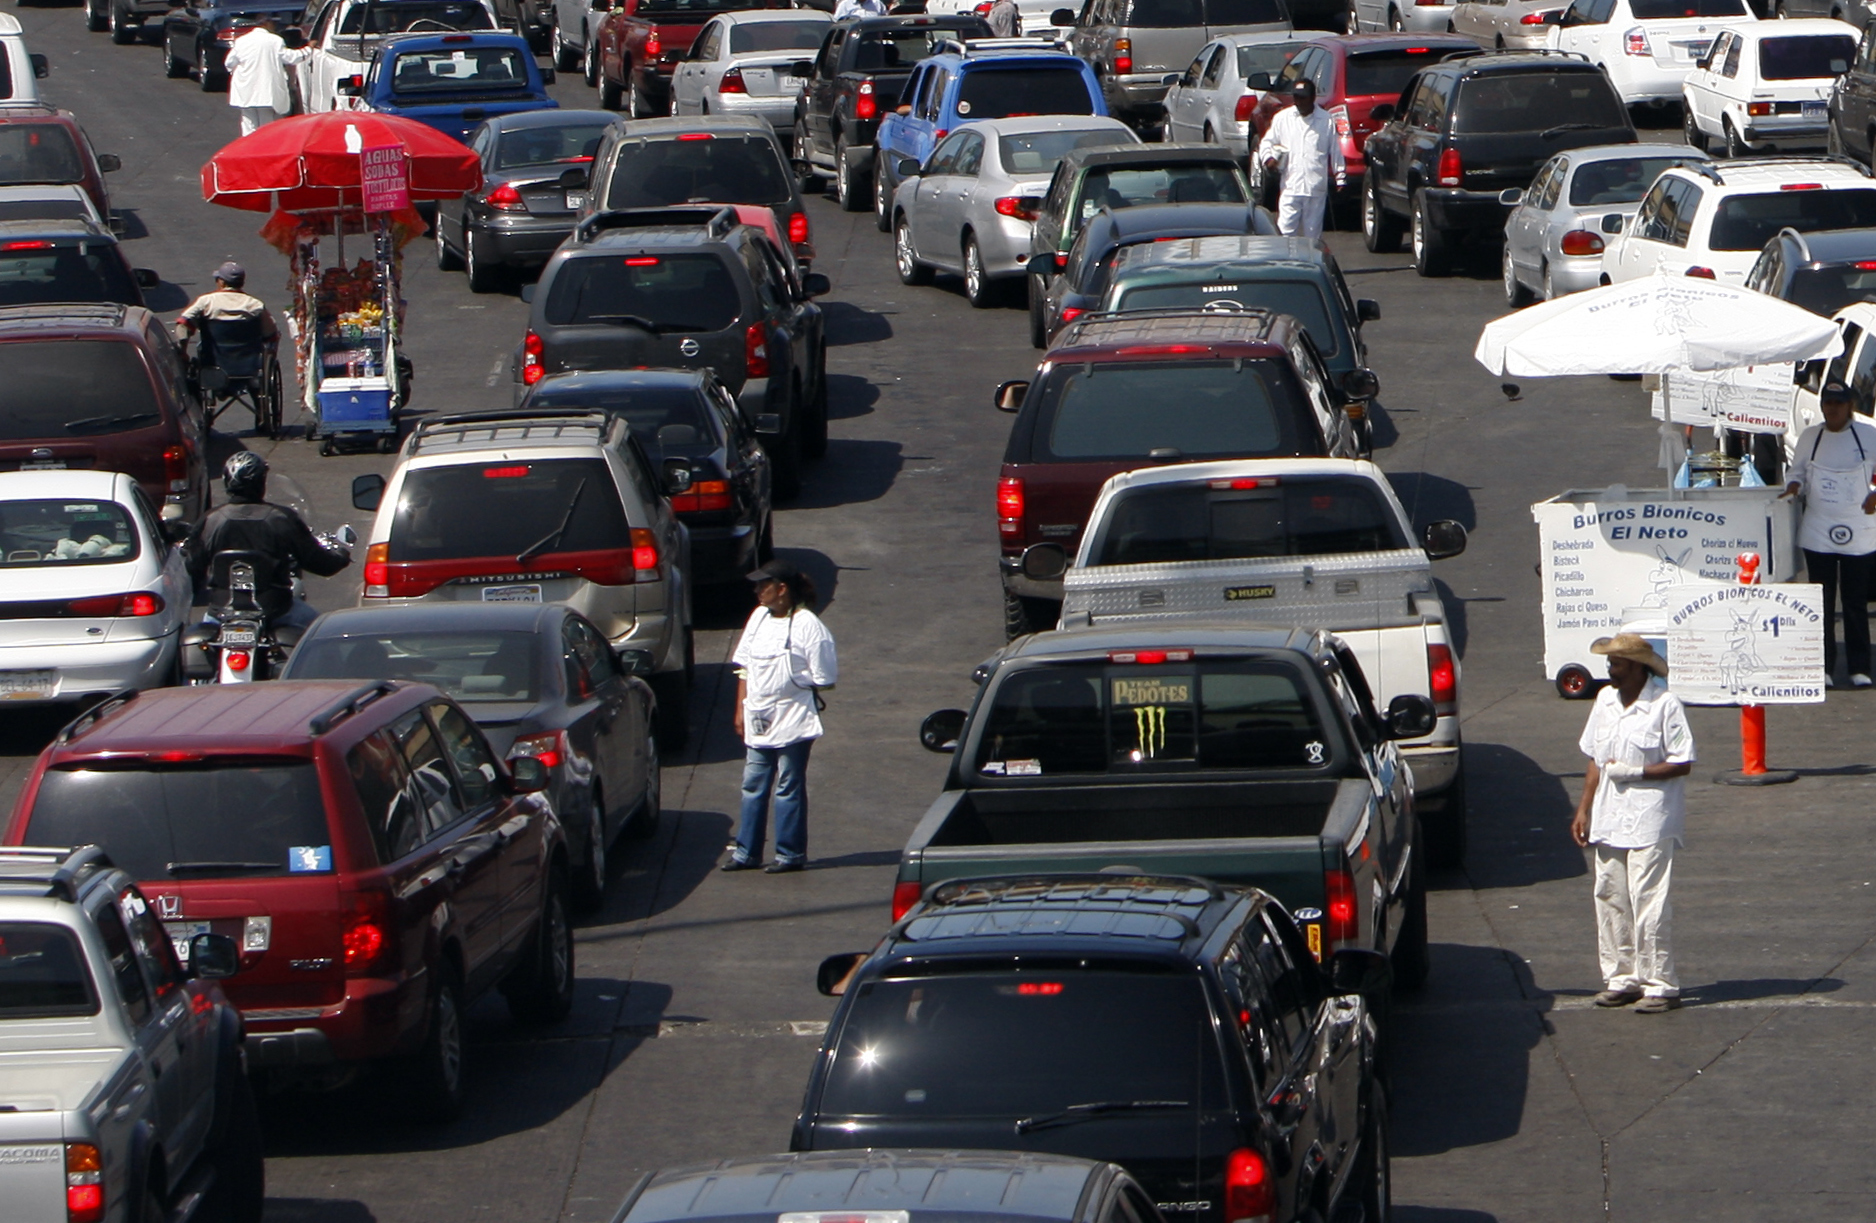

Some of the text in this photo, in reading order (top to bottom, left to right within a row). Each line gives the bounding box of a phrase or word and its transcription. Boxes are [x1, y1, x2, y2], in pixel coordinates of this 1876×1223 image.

[364, 149, 403, 165] AGUAS
[365, 165, 399, 178] SODAS
[1726, 411, 1787, 429] Calientitos
[1573, 504, 1727, 529] Burros Bionicos
[1610, 526, 1689, 540] El Neto
[1552, 539, 1594, 551] Deshebrada
[1701, 538, 1727, 549] Chorizo
[1553, 555, 1580, 567] Bisteck
[1705, 554, 1732, 566] Chorizo
[469, 572, 561, 584] MITSUBISHI
[1554, 571, 1585, 582] Picadillo
[1237, 586, 1275, 599] HUSKY
[1555, 586, 1594, 597] Chicharron
[1556, 602, 1576, 614] Rajas
[1585, 601, 1608, 613] Queso
[1672, 593, 1714, 626] BURROS
[1774, 592, 1787, 605] EL
[1789, 599, 1820, 623] NETO
[1762, 614, 1779, 638] $1
[1130, 680, 1160, 688] TEAM
[1751, 685, 1821, 698] Calientitos
